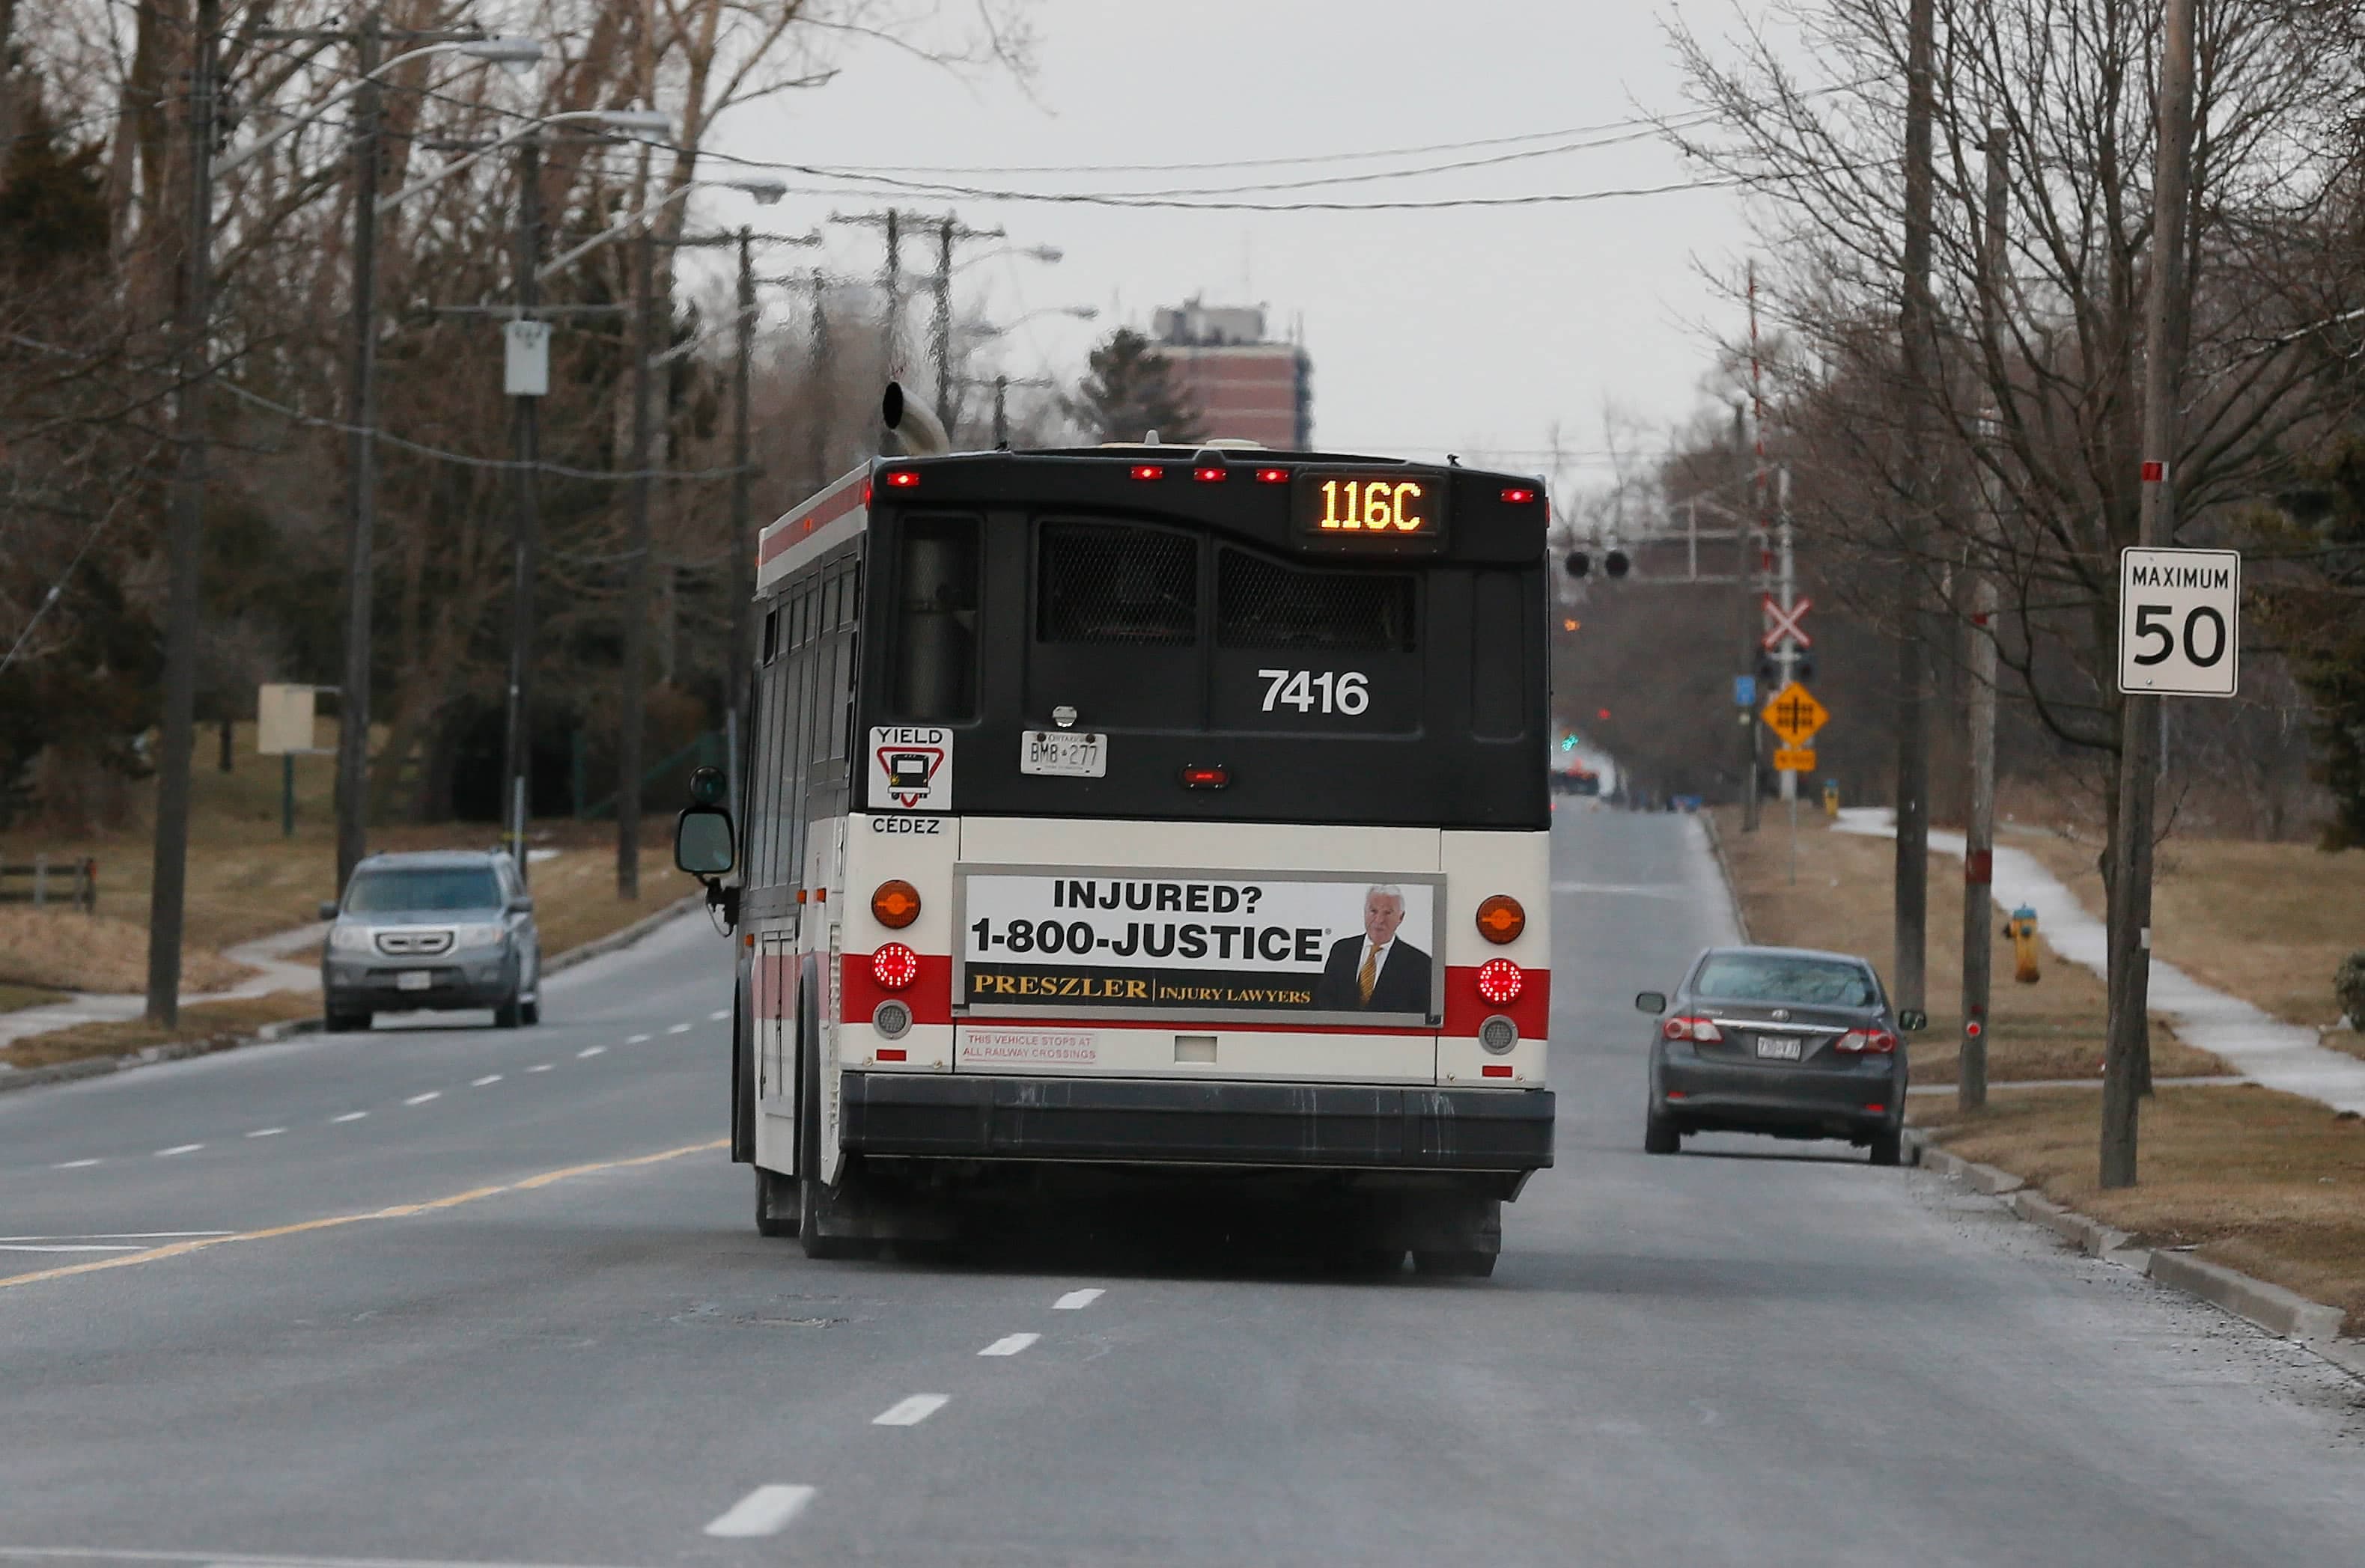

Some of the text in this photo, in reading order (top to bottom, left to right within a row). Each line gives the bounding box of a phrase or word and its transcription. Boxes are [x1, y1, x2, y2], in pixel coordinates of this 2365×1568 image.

[1321, 481, 1421, 530] 116C
[2132, 566, 2229, 589] MAXIMUM
[2134, 605, 2226, 668] 50
[1258, 670, 1369, 716] 7416
[877, 728, 943, 744] YIELD
[872, 814, 940, 834] CÉDEZ
[1053, 880, 1262, 914] INJURED?
[973, 974, 1311, 1004] PRESZLER INJURY LAWYERS
[963, 1047, 1096, 1059] ALL RAILWAY CROSSINGS
[969, 1035, 1090, 1046] THIS VEHICLE STOPS AT
